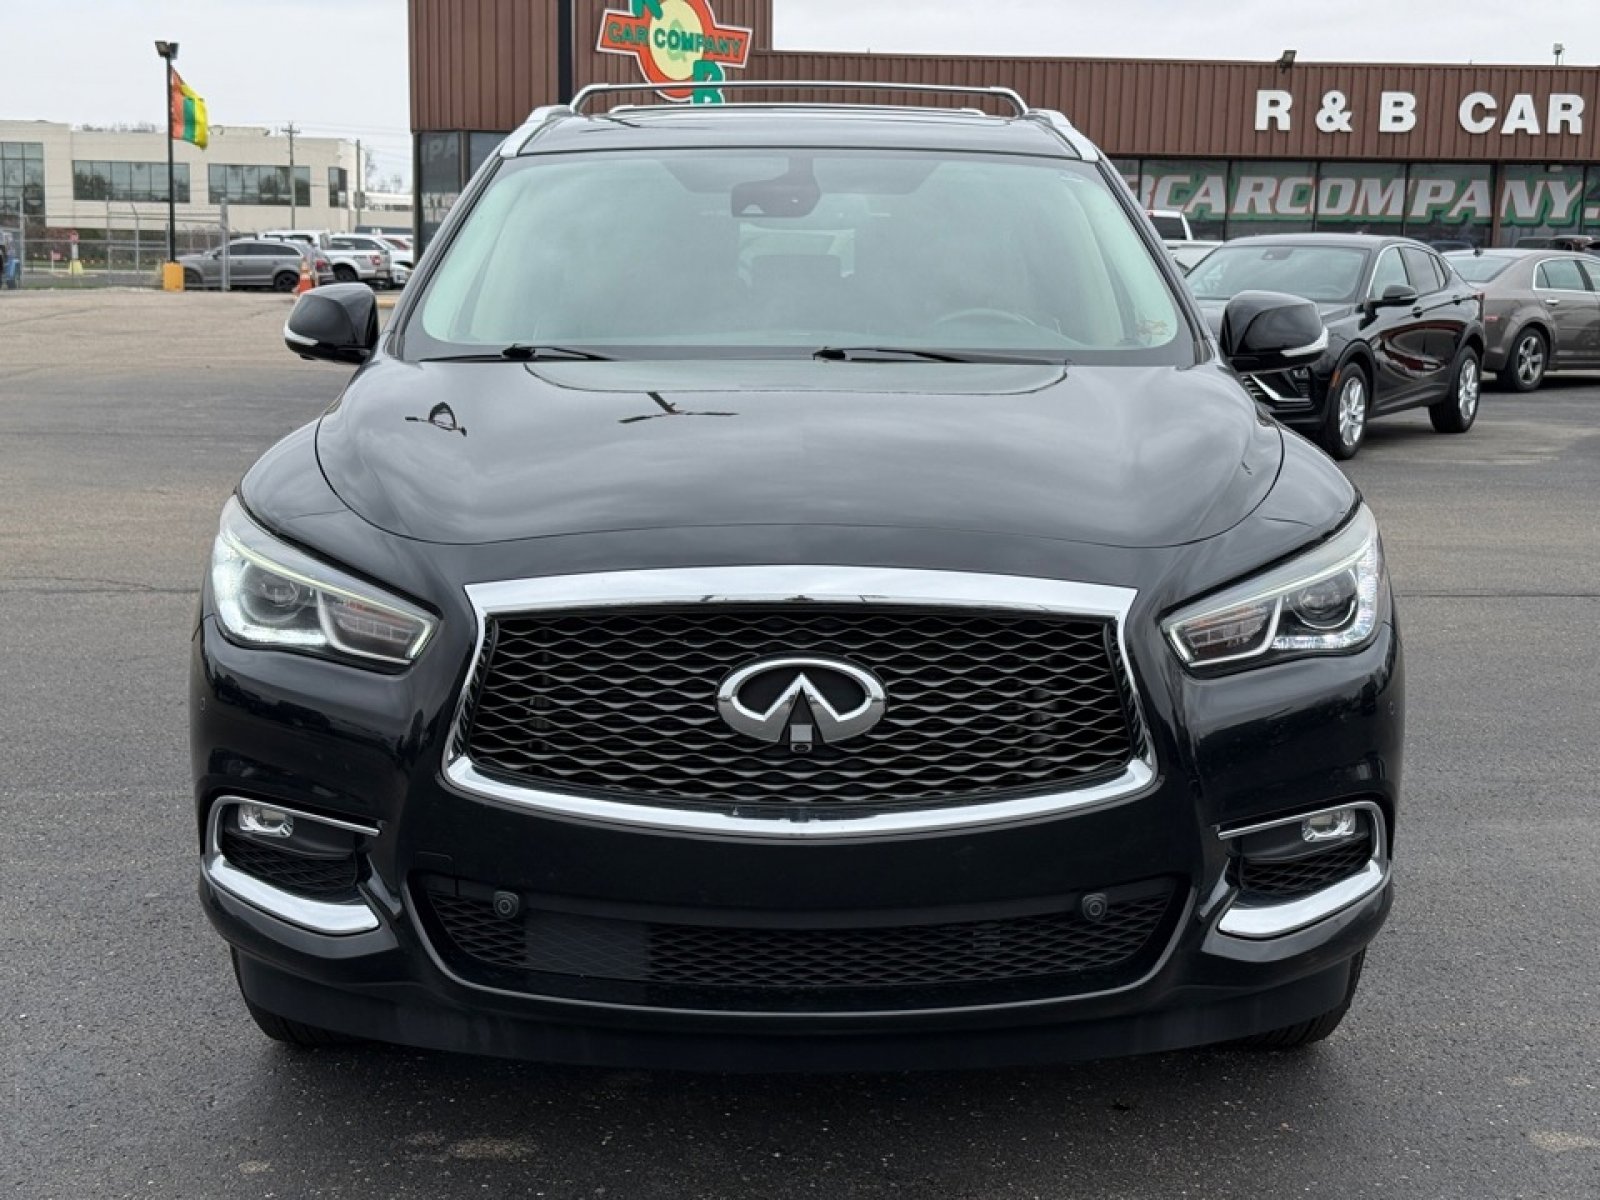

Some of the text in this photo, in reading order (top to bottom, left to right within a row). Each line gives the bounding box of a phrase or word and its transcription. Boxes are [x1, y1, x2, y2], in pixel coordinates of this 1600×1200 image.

[607, 22, 743, 58] CAR COMPANY
[1255, 89, 1586, 134] R & B CAR
